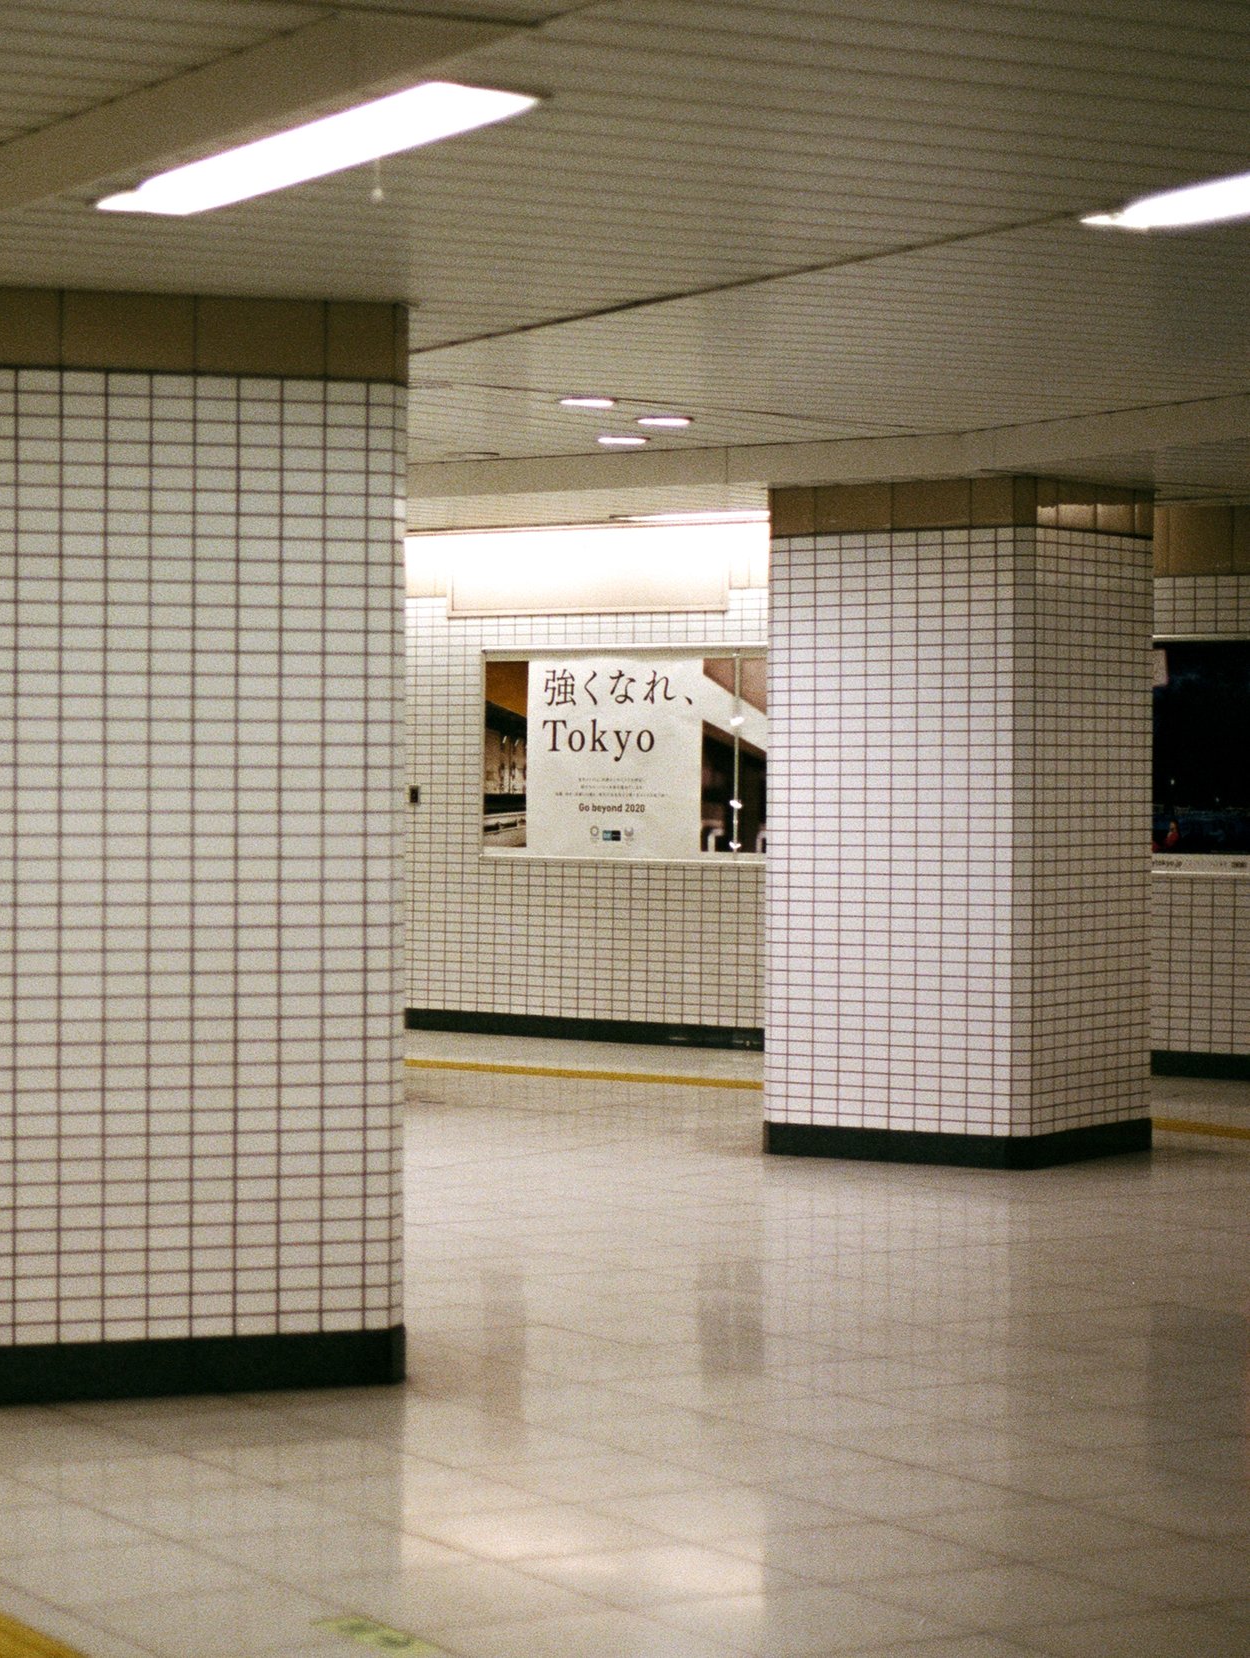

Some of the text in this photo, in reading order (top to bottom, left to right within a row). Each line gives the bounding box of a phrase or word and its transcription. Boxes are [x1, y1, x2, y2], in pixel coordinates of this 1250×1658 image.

[544, 669, 693, 706] 強くなれ、
[542, 719, 655, 762] Tokyo
[578, 802, 646, 814] Go beyond 2020
